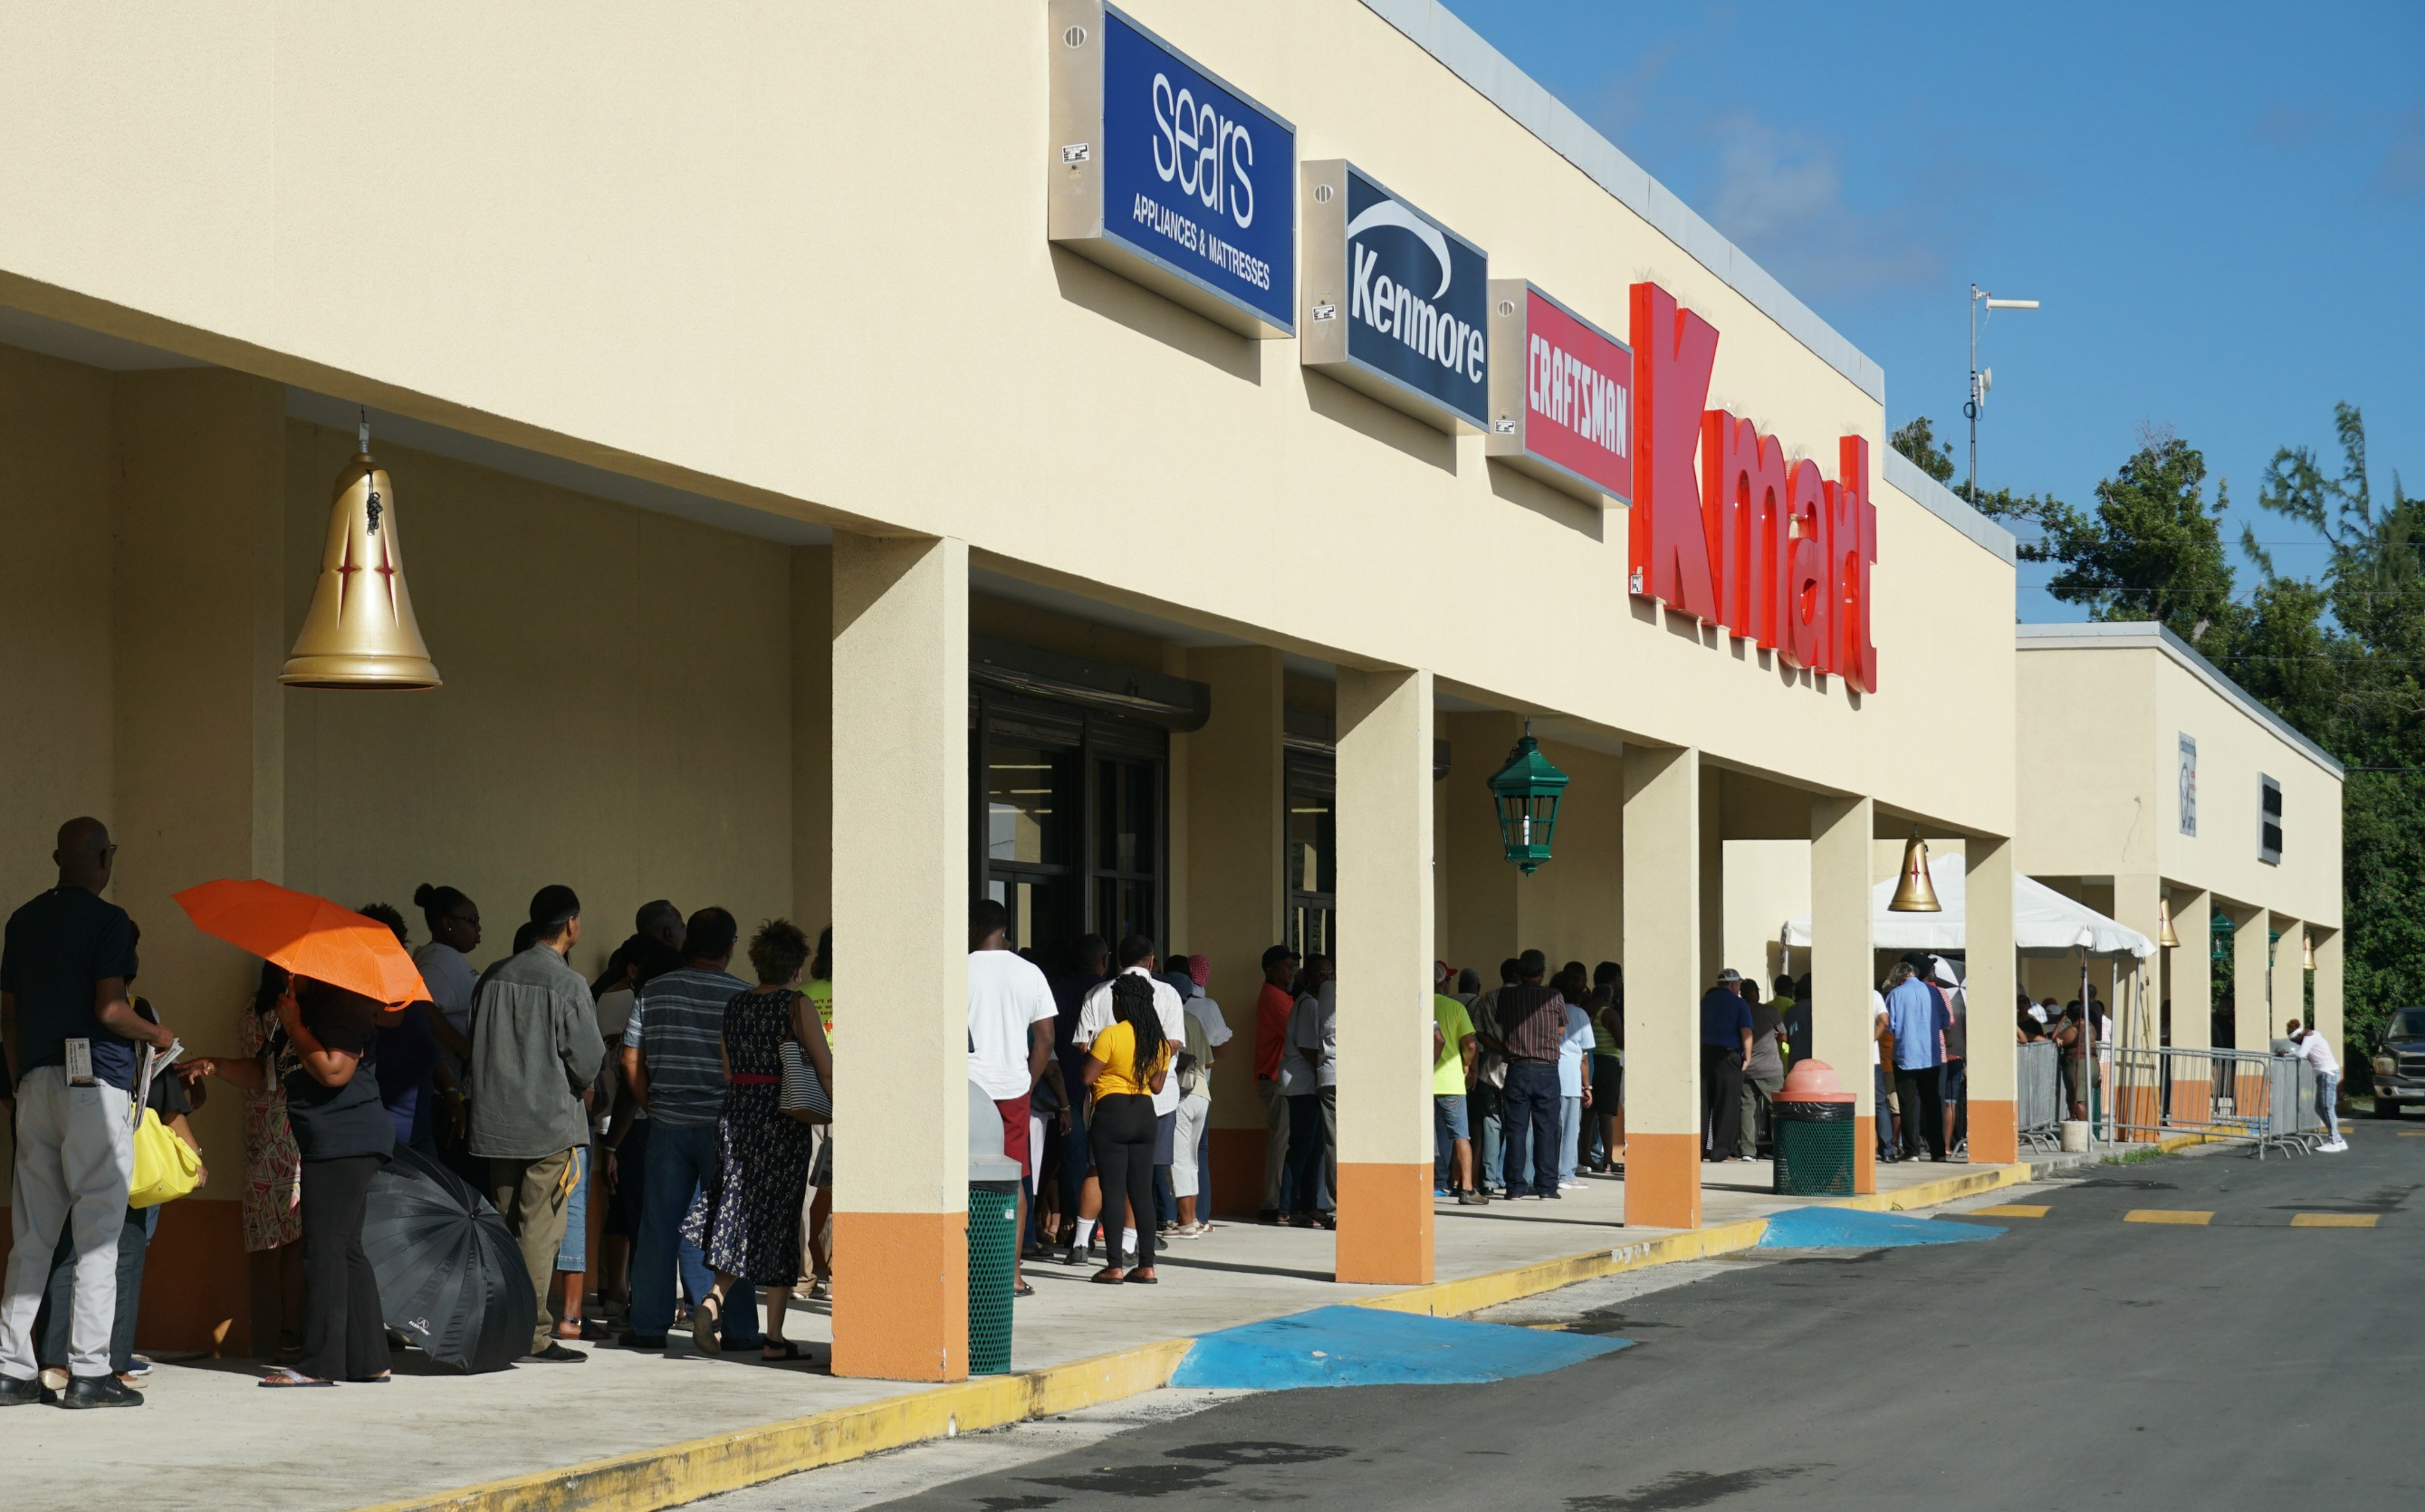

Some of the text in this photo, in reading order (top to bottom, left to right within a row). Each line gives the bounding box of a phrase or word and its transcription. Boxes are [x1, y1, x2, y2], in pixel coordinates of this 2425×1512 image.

[1153, 72, 1254, 228] sears
[1133, 192, 1270, 291] APPLIANCES & MATTRESSES
[1351, 241, 1485, 384] Kenmore
[1529, 332, 1627, 458] CRAFTSMAN
[1629, 281, 1877, 694] Kmart
